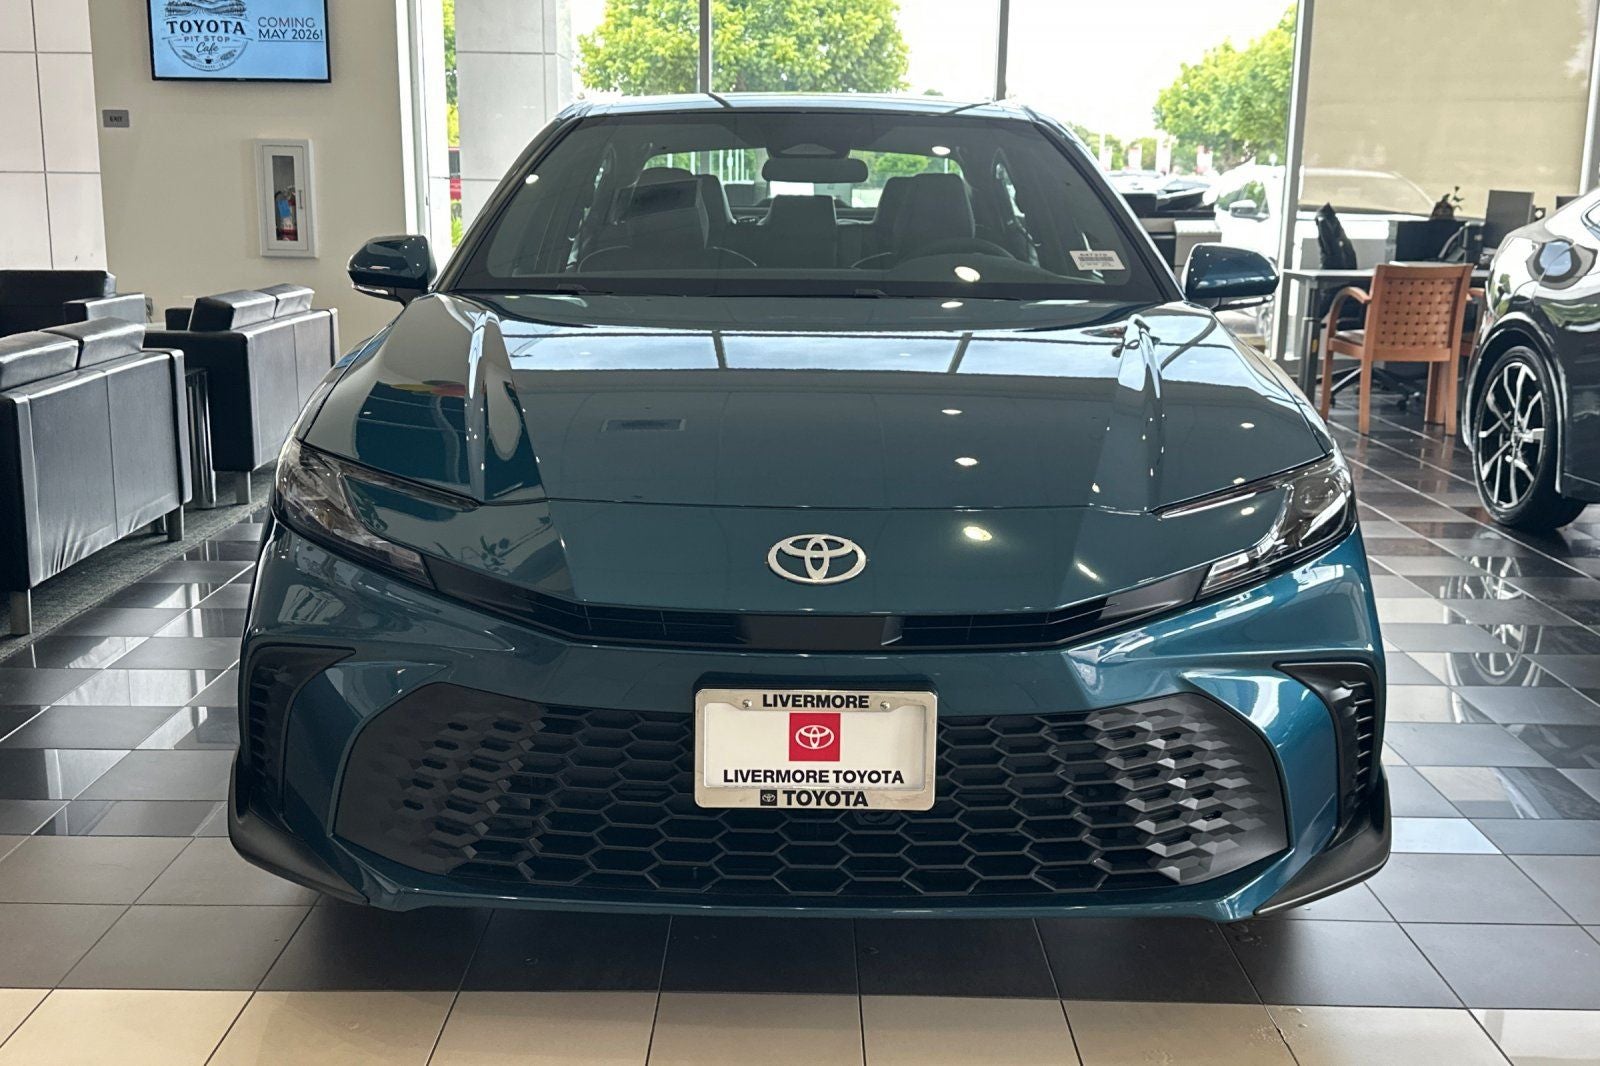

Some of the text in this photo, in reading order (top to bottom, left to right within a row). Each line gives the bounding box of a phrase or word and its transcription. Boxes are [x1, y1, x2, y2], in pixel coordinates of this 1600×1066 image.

[166, 19, 246, 35] TOYOTA
[257, 16, 315, 28] COMING
[258, 29, 323, 40] MAY 2026!
[762, 694, 869, 709] LIVERMORE
[723, 769, 904, 784] LIVERMORE TOYOTA
[782, 790, 868, 807] TOYOTA
